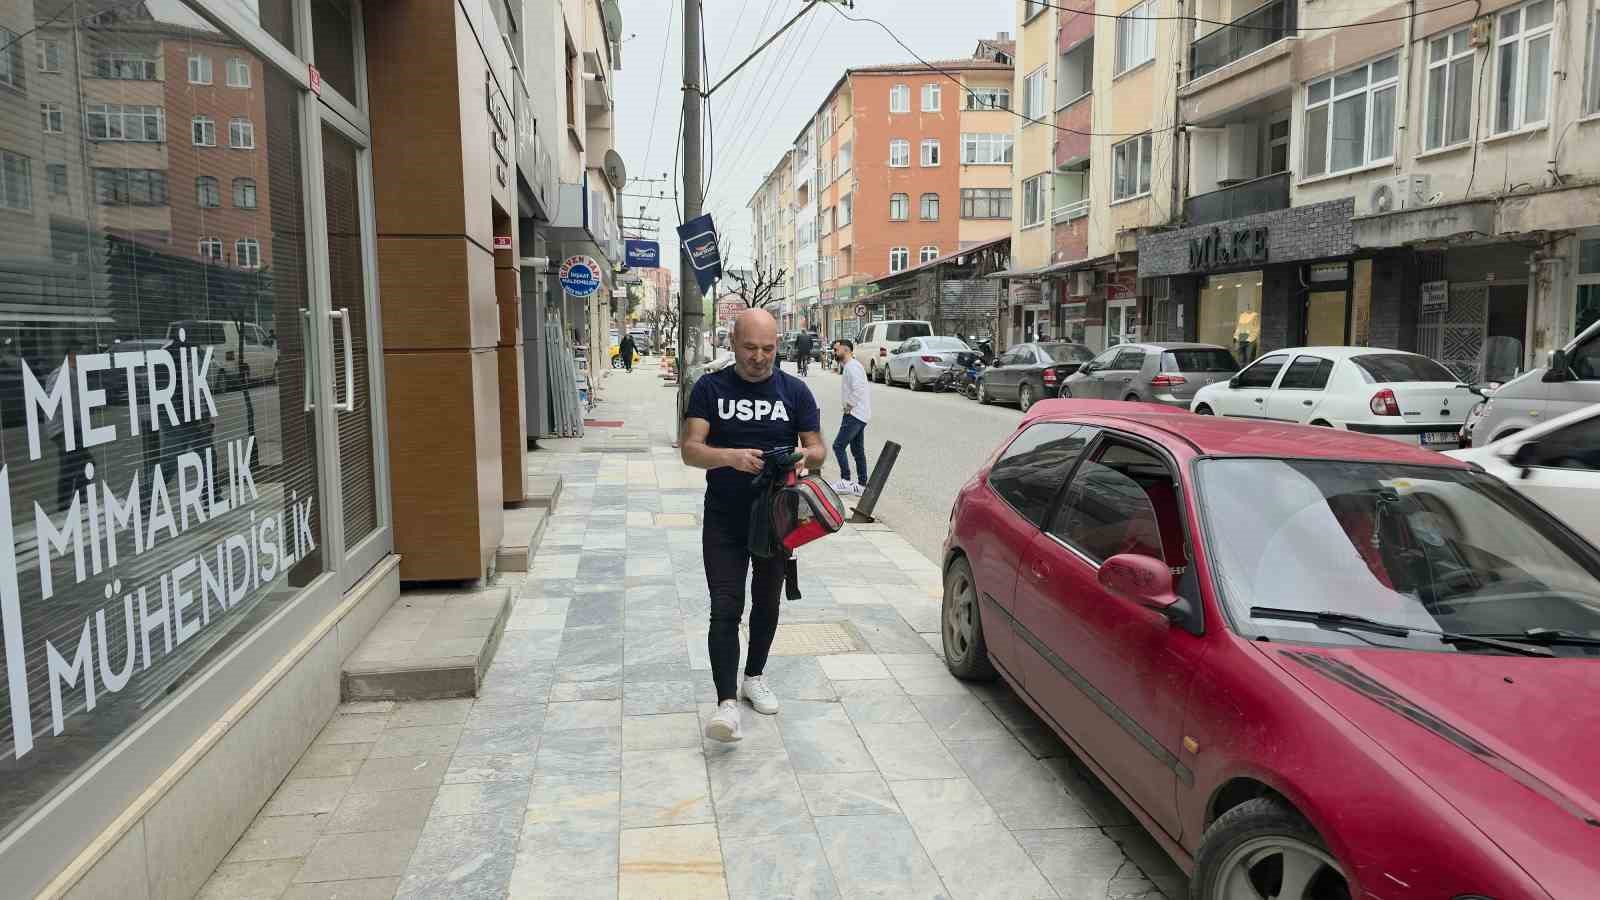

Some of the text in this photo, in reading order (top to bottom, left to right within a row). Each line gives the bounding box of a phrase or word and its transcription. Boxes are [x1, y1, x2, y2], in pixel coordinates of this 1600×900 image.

[22, 328, 218, 461] METRİK
[717, 398, 790, 422] USPA
[35, 436, 259, 601] MİMARLIK
[46, 490, 316, 738] MÜHENDİSLİK
